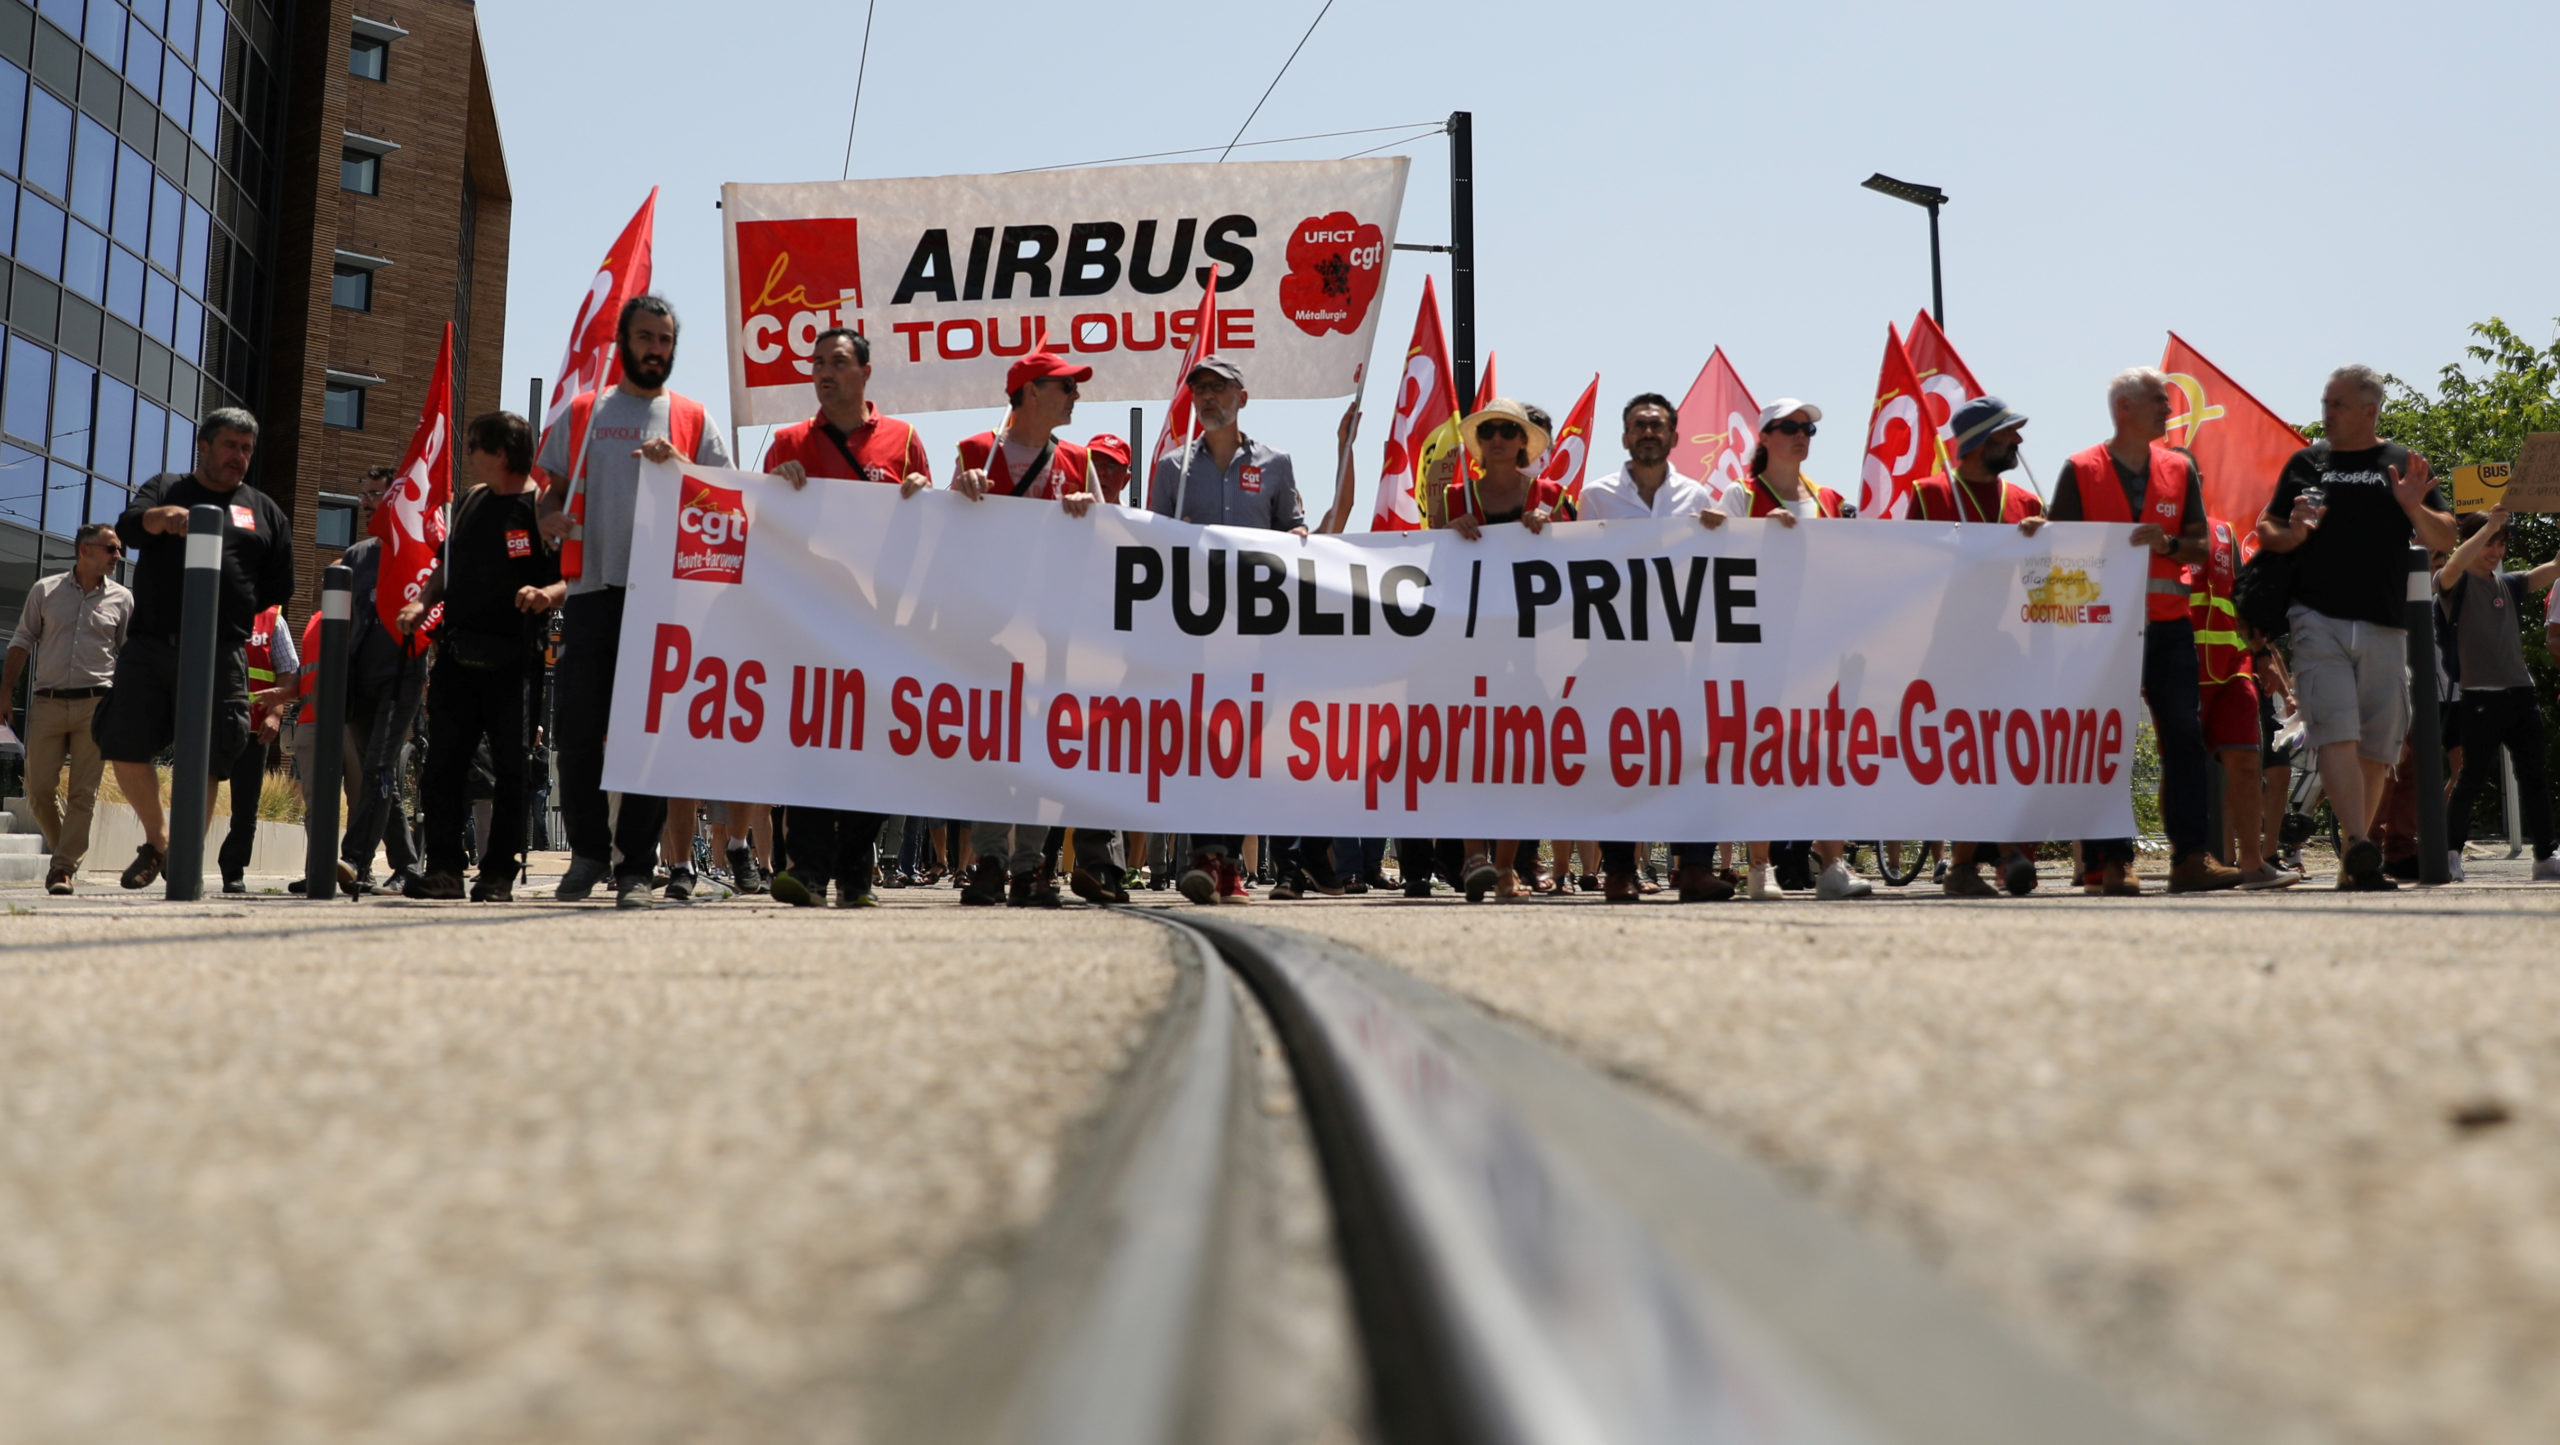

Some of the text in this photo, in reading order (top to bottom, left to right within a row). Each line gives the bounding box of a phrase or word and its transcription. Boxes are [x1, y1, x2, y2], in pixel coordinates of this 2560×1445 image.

[1304, 230, 1356, 243] UFICT
[890, 214, 1257, 305] AIRBUS
[1350, 241, 1382, 270] cgt
[750, 251, 856, 313] la
[1294, 308, 1348, 323] Métallurgie
[892, 307, 1256, 364] TOULOUSE
[2482, 465, 2509, 479] BUS
[2156, 502, 2177, 518] cgt
[2456, 498, 2484, 508] Daurat
[680, 507, 747, 545] cgt
[507, 536, 530, 550] cgt
[1114, 546, 1763, 644] PUBLIC / PRIVE
[2020, 603, 2088, 624] OCCITANIE
[250, 632, 269, 647] gt
[645, 623, 2122, 811] Pas un seul emploi supprimé en Haute-Garonne
